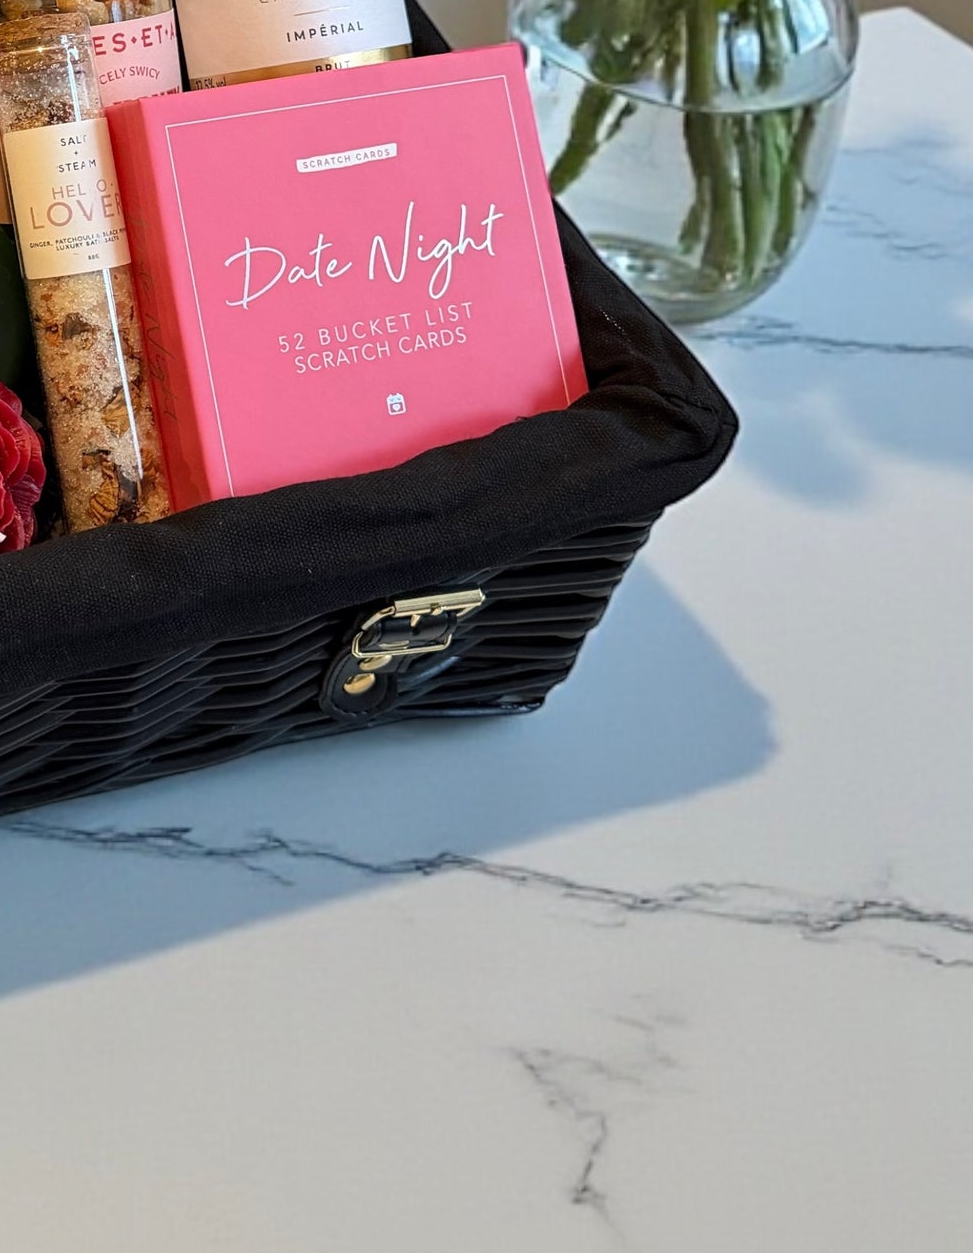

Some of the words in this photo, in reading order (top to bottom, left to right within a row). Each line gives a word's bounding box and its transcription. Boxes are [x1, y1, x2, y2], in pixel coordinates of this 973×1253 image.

[286, 21, 364, 43] IMPÉRIAL
[129, 65, 161, 80] SWICY
[58, 158, 97, 173] STEAM
[302, 154, 352, 169] SCRATCH
[355, 147, 391, 162] CARDS
[224, 233, 353, 310] Date
[368, 201, 505, 300] Night
[278, 332, 305, 353] 52
[318, 313, 412, 345] BUCKET
[426, 302, 473, 326] LIST
[294, 341, 390, 374] SCRATCH
[398, 326, 467, 354] CARDS
